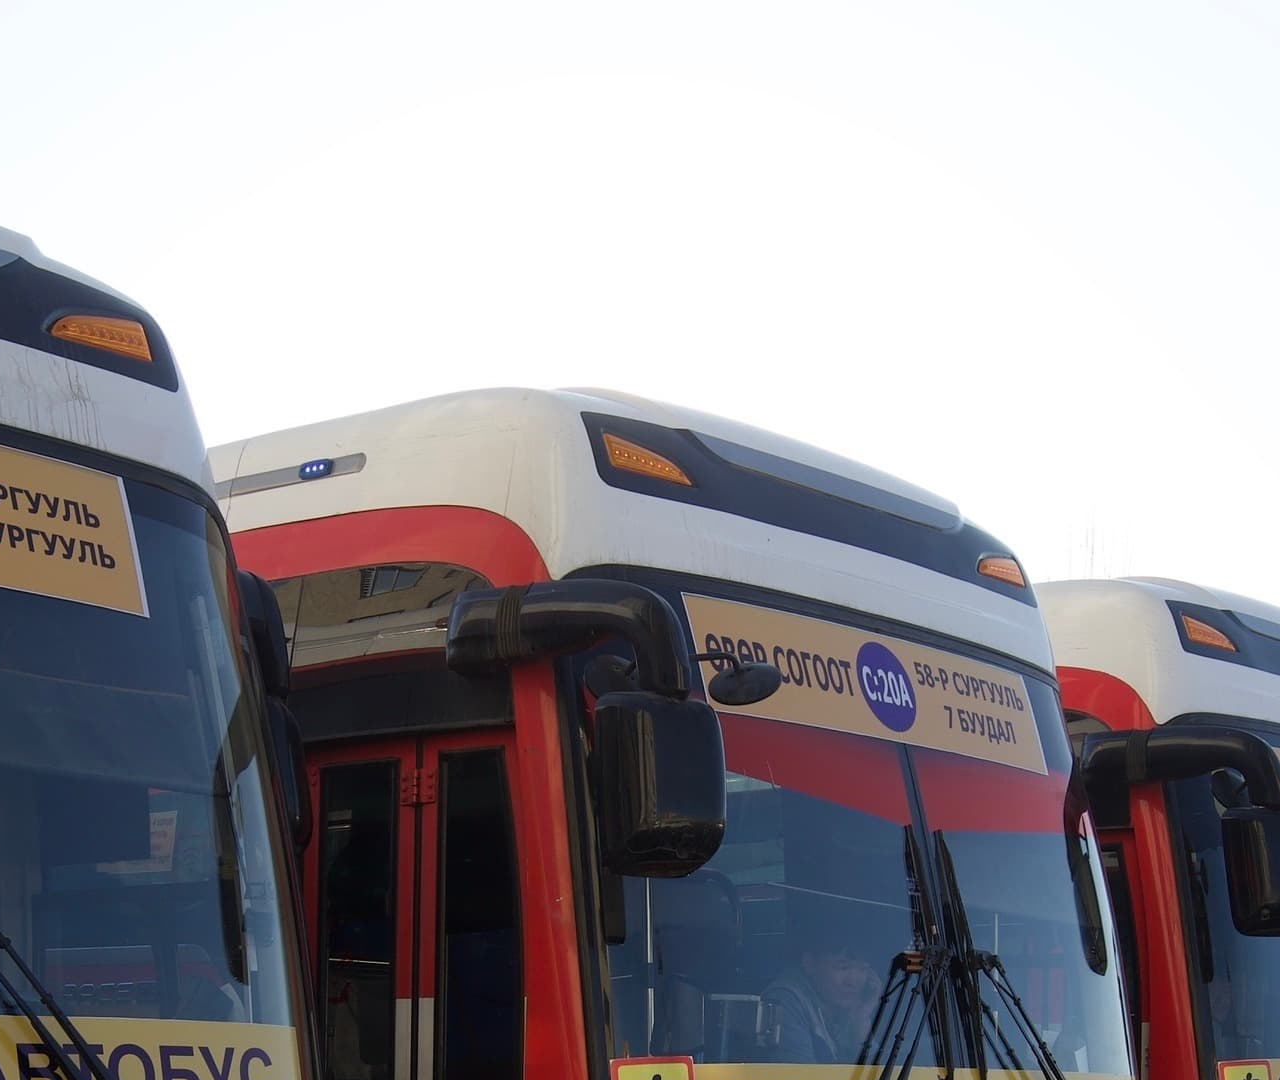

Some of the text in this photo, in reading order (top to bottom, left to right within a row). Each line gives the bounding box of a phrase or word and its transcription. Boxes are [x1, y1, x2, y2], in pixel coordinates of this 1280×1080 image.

[773, 645, 855, 697] СОГООТ
[861, 665, 914, 709] С:20А
[913, 661, 1025, 712] 58-Р СУРГУУЛЬ
[943, 705, 1017, 745] 7 БУУДАЛ
